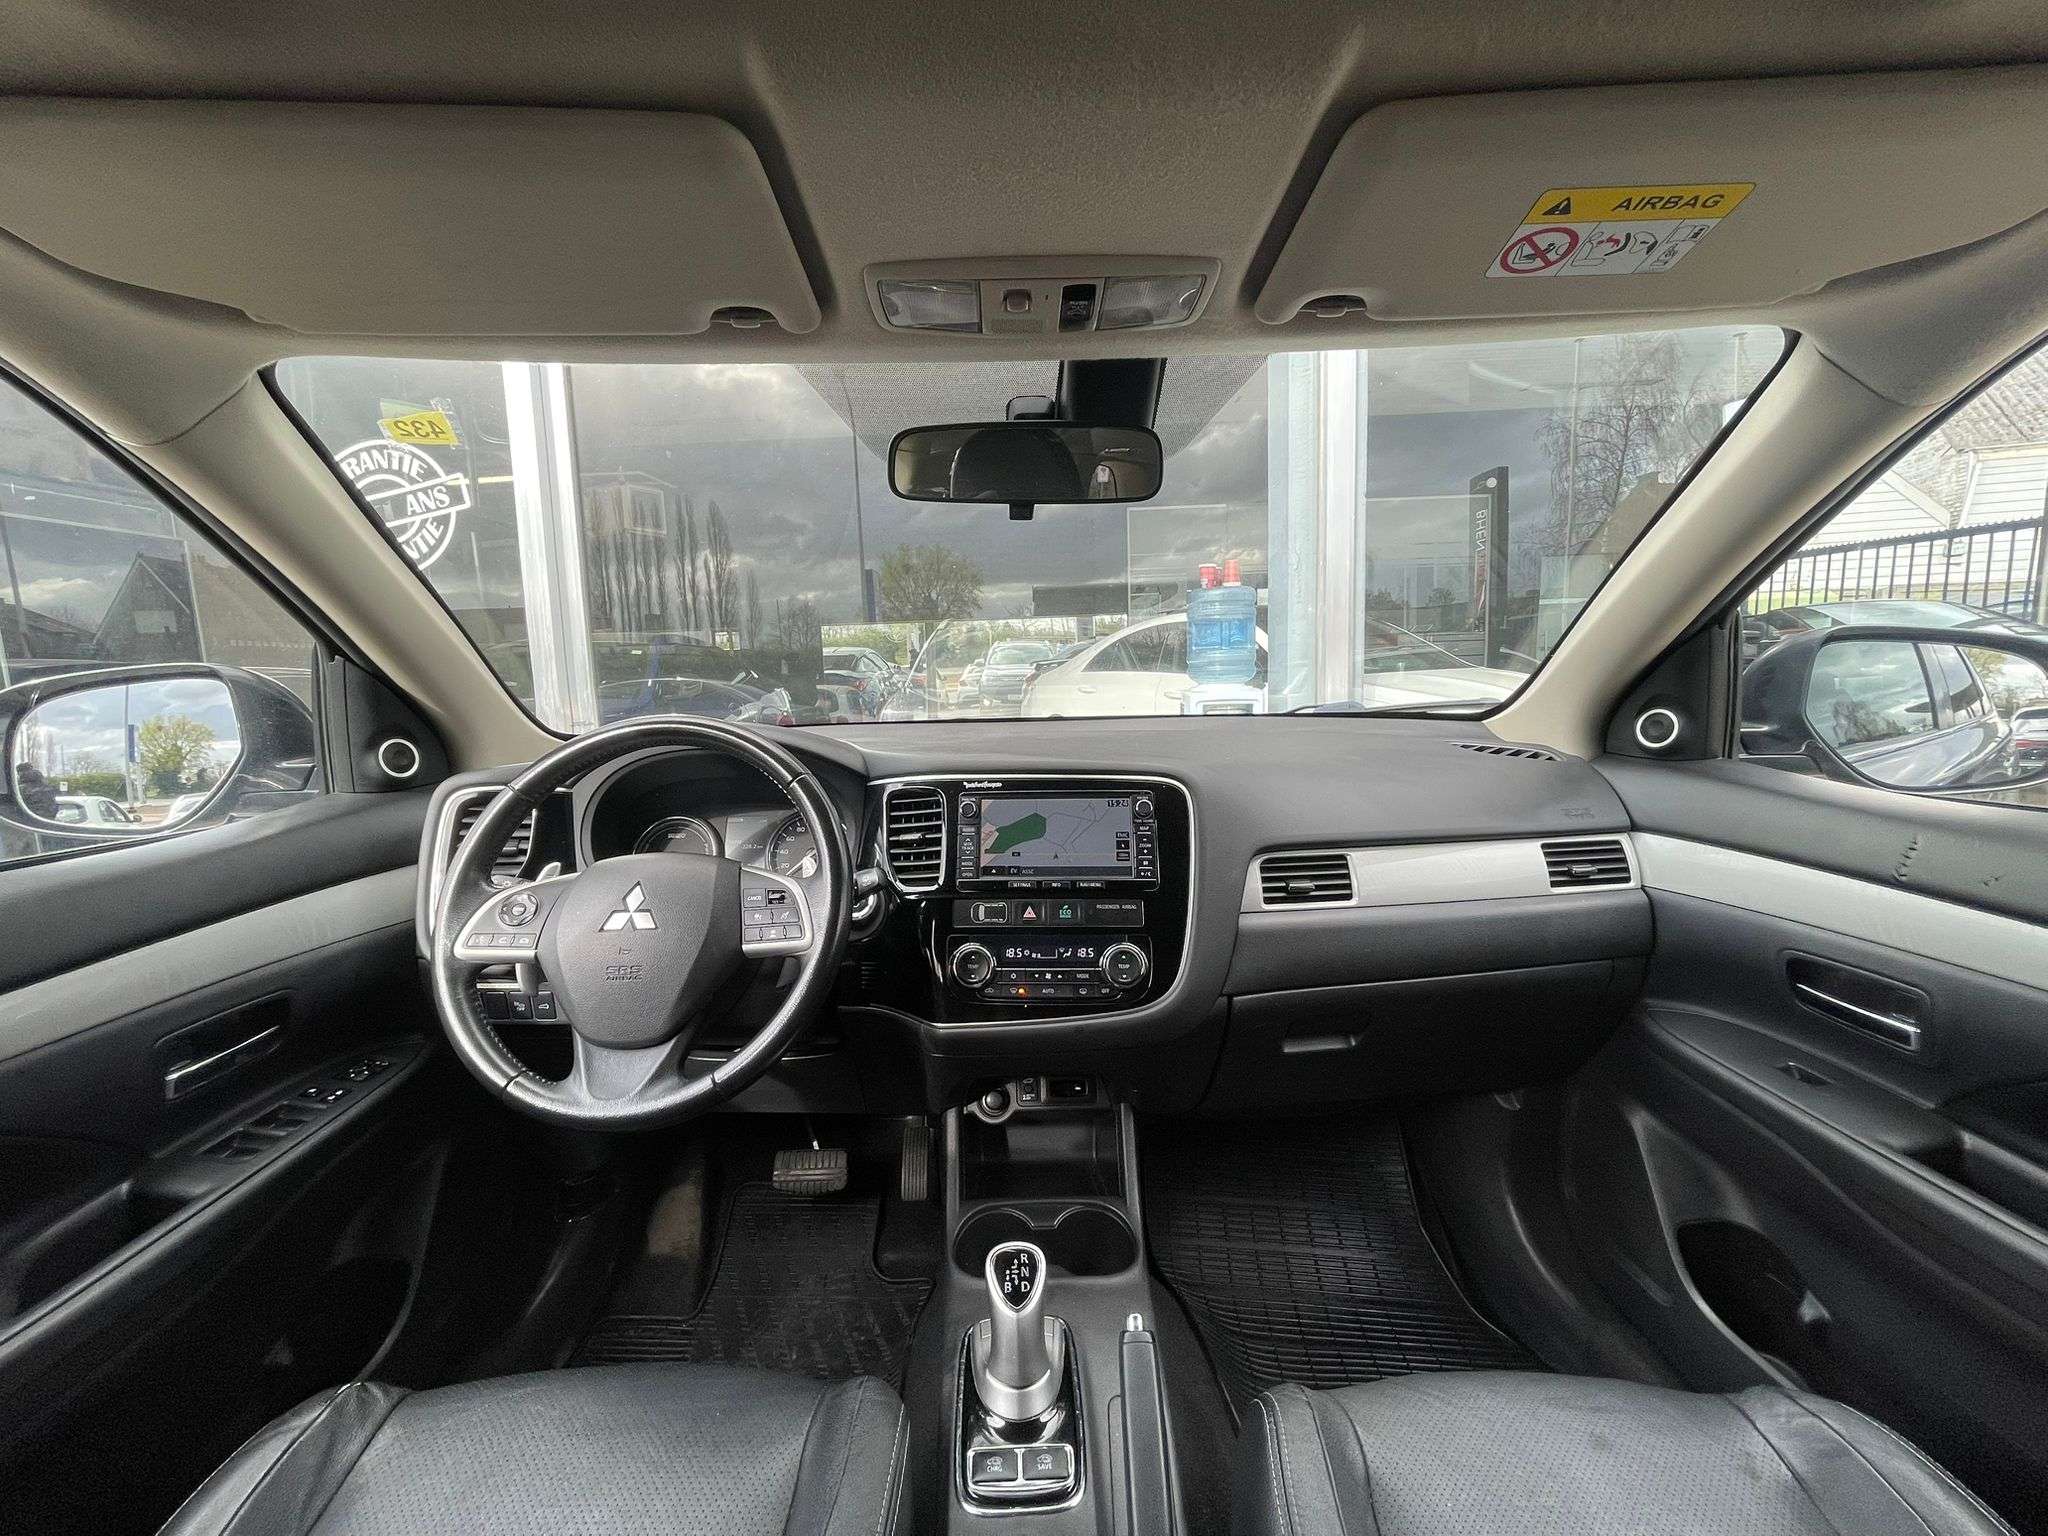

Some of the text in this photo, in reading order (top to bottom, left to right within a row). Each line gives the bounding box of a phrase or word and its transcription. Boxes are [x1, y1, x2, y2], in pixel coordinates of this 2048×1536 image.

[1611, 194, 1726, 213] AIRBAG
[406, 486, 451, 515] ANS
[1020, 1253, 1029, 1264] R
[1020, 1266, 1030, 1277] N
[1004, 1281, 1012, 1294] B
[1020, 1281, 1031, 1292] D
